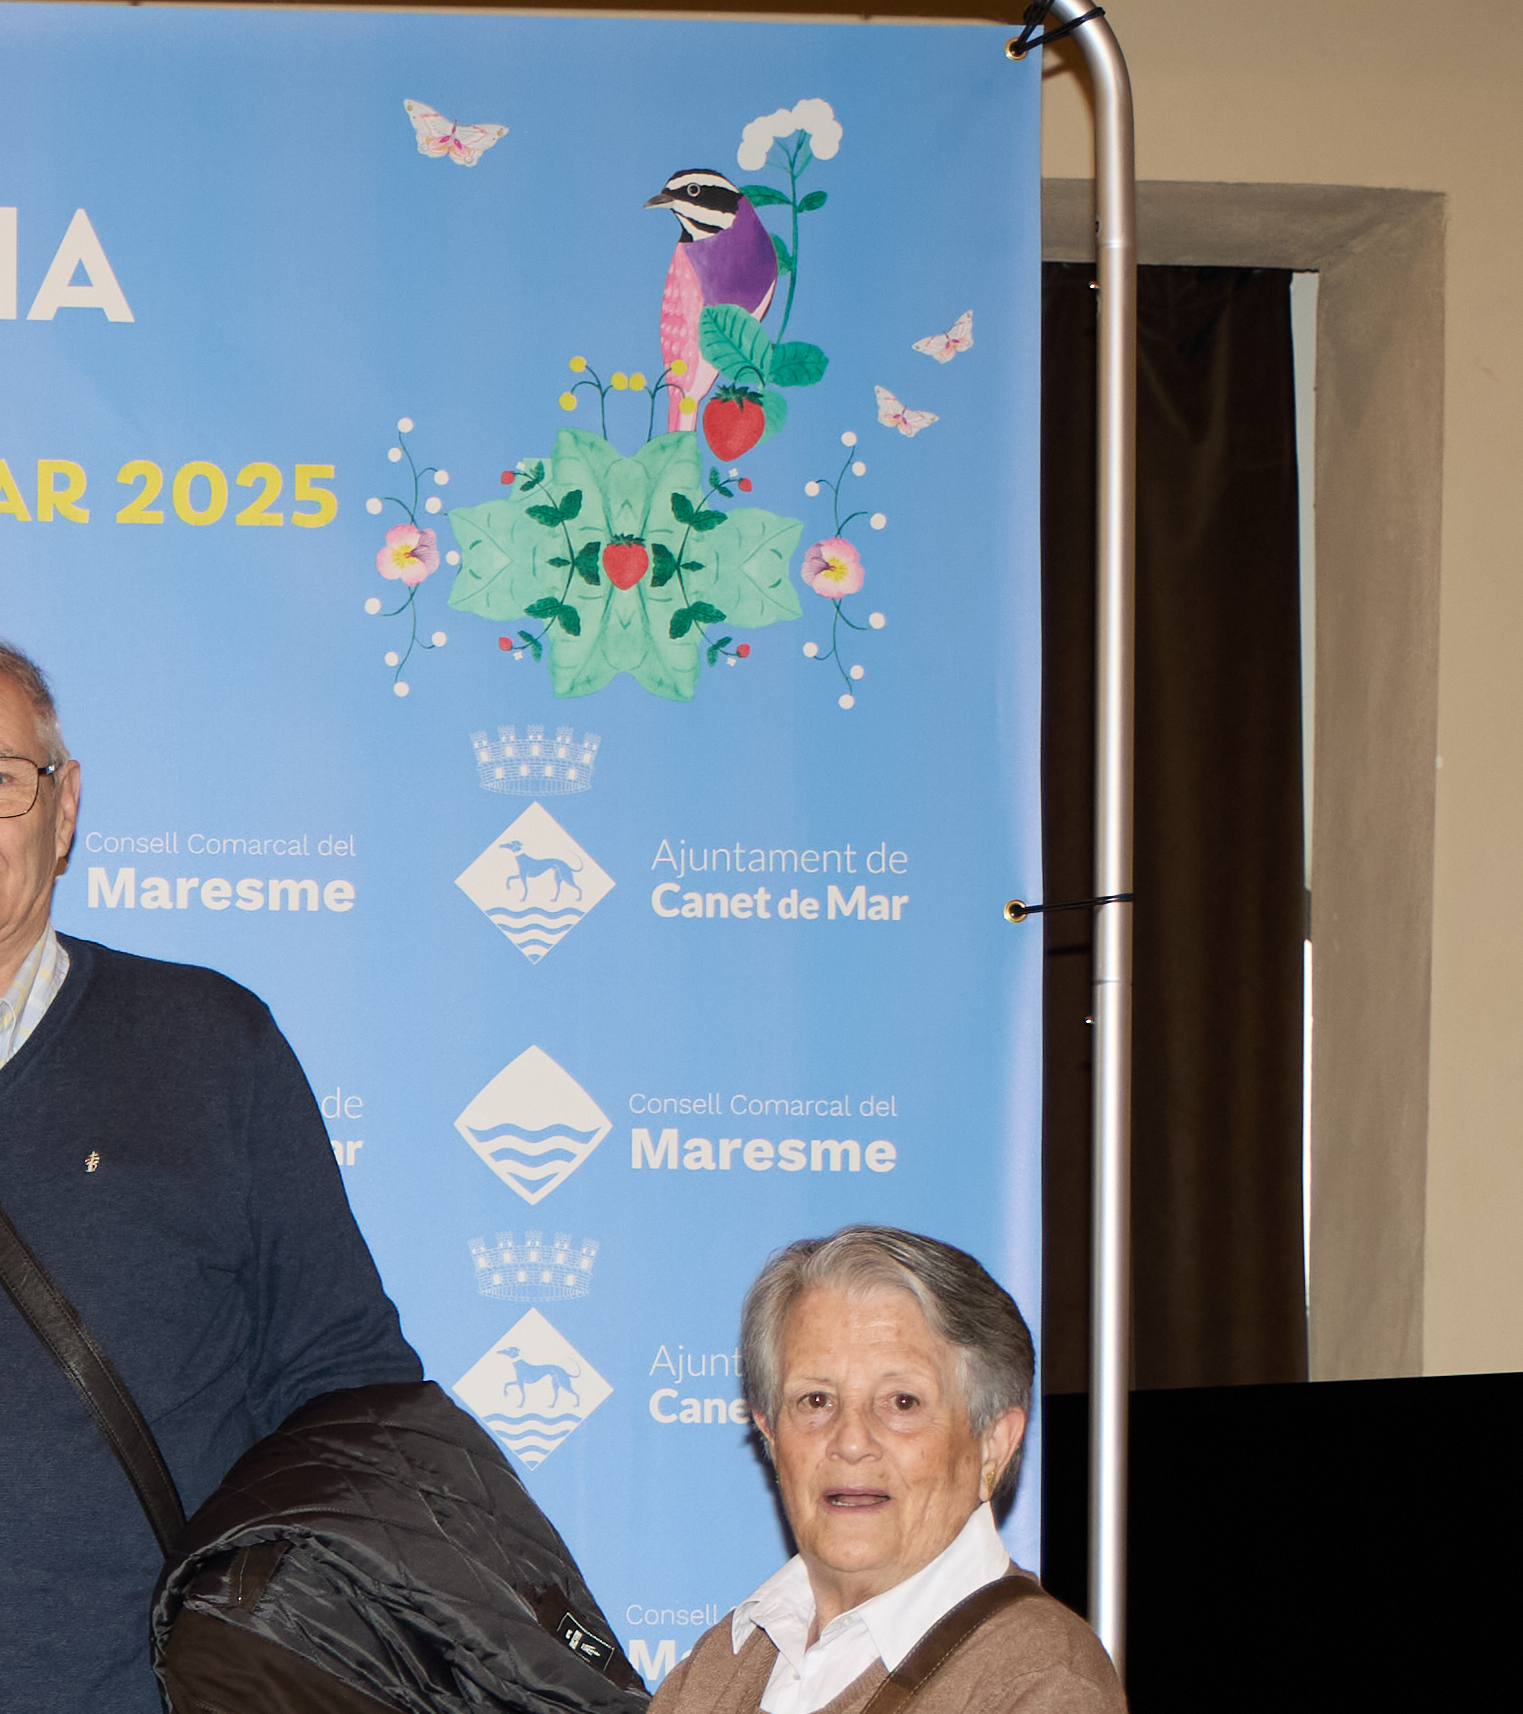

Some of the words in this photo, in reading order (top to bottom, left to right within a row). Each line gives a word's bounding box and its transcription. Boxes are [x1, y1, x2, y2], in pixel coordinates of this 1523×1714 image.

[116, 459, 338, 528] 2025
[85, 831, 179, 854] Consell
[187, 833, 308, 856] Comarcal
[317, 834, 356, 857] del
[651, 838, 857, 878] Ajuntament
[866, 841, 909, 874] de
[88, 866, 356, 912] Maresme
[651, 883, 772, 919] Canet
[777, 888, 820, 920] de
[827, 883, 910, 921] Mar
[628, 1092, 722, 1115] Consell
[729, 1093, 850, 1117] Comarcal
[859, 1094, 898, 1117] del
[631, 1127, 897, 1173] Maresme
[649, 1344, 742, 1384] Ajunt
[648, 1387, 752, 1424] Cane
[624, 1604, 720, 1630] Consell
